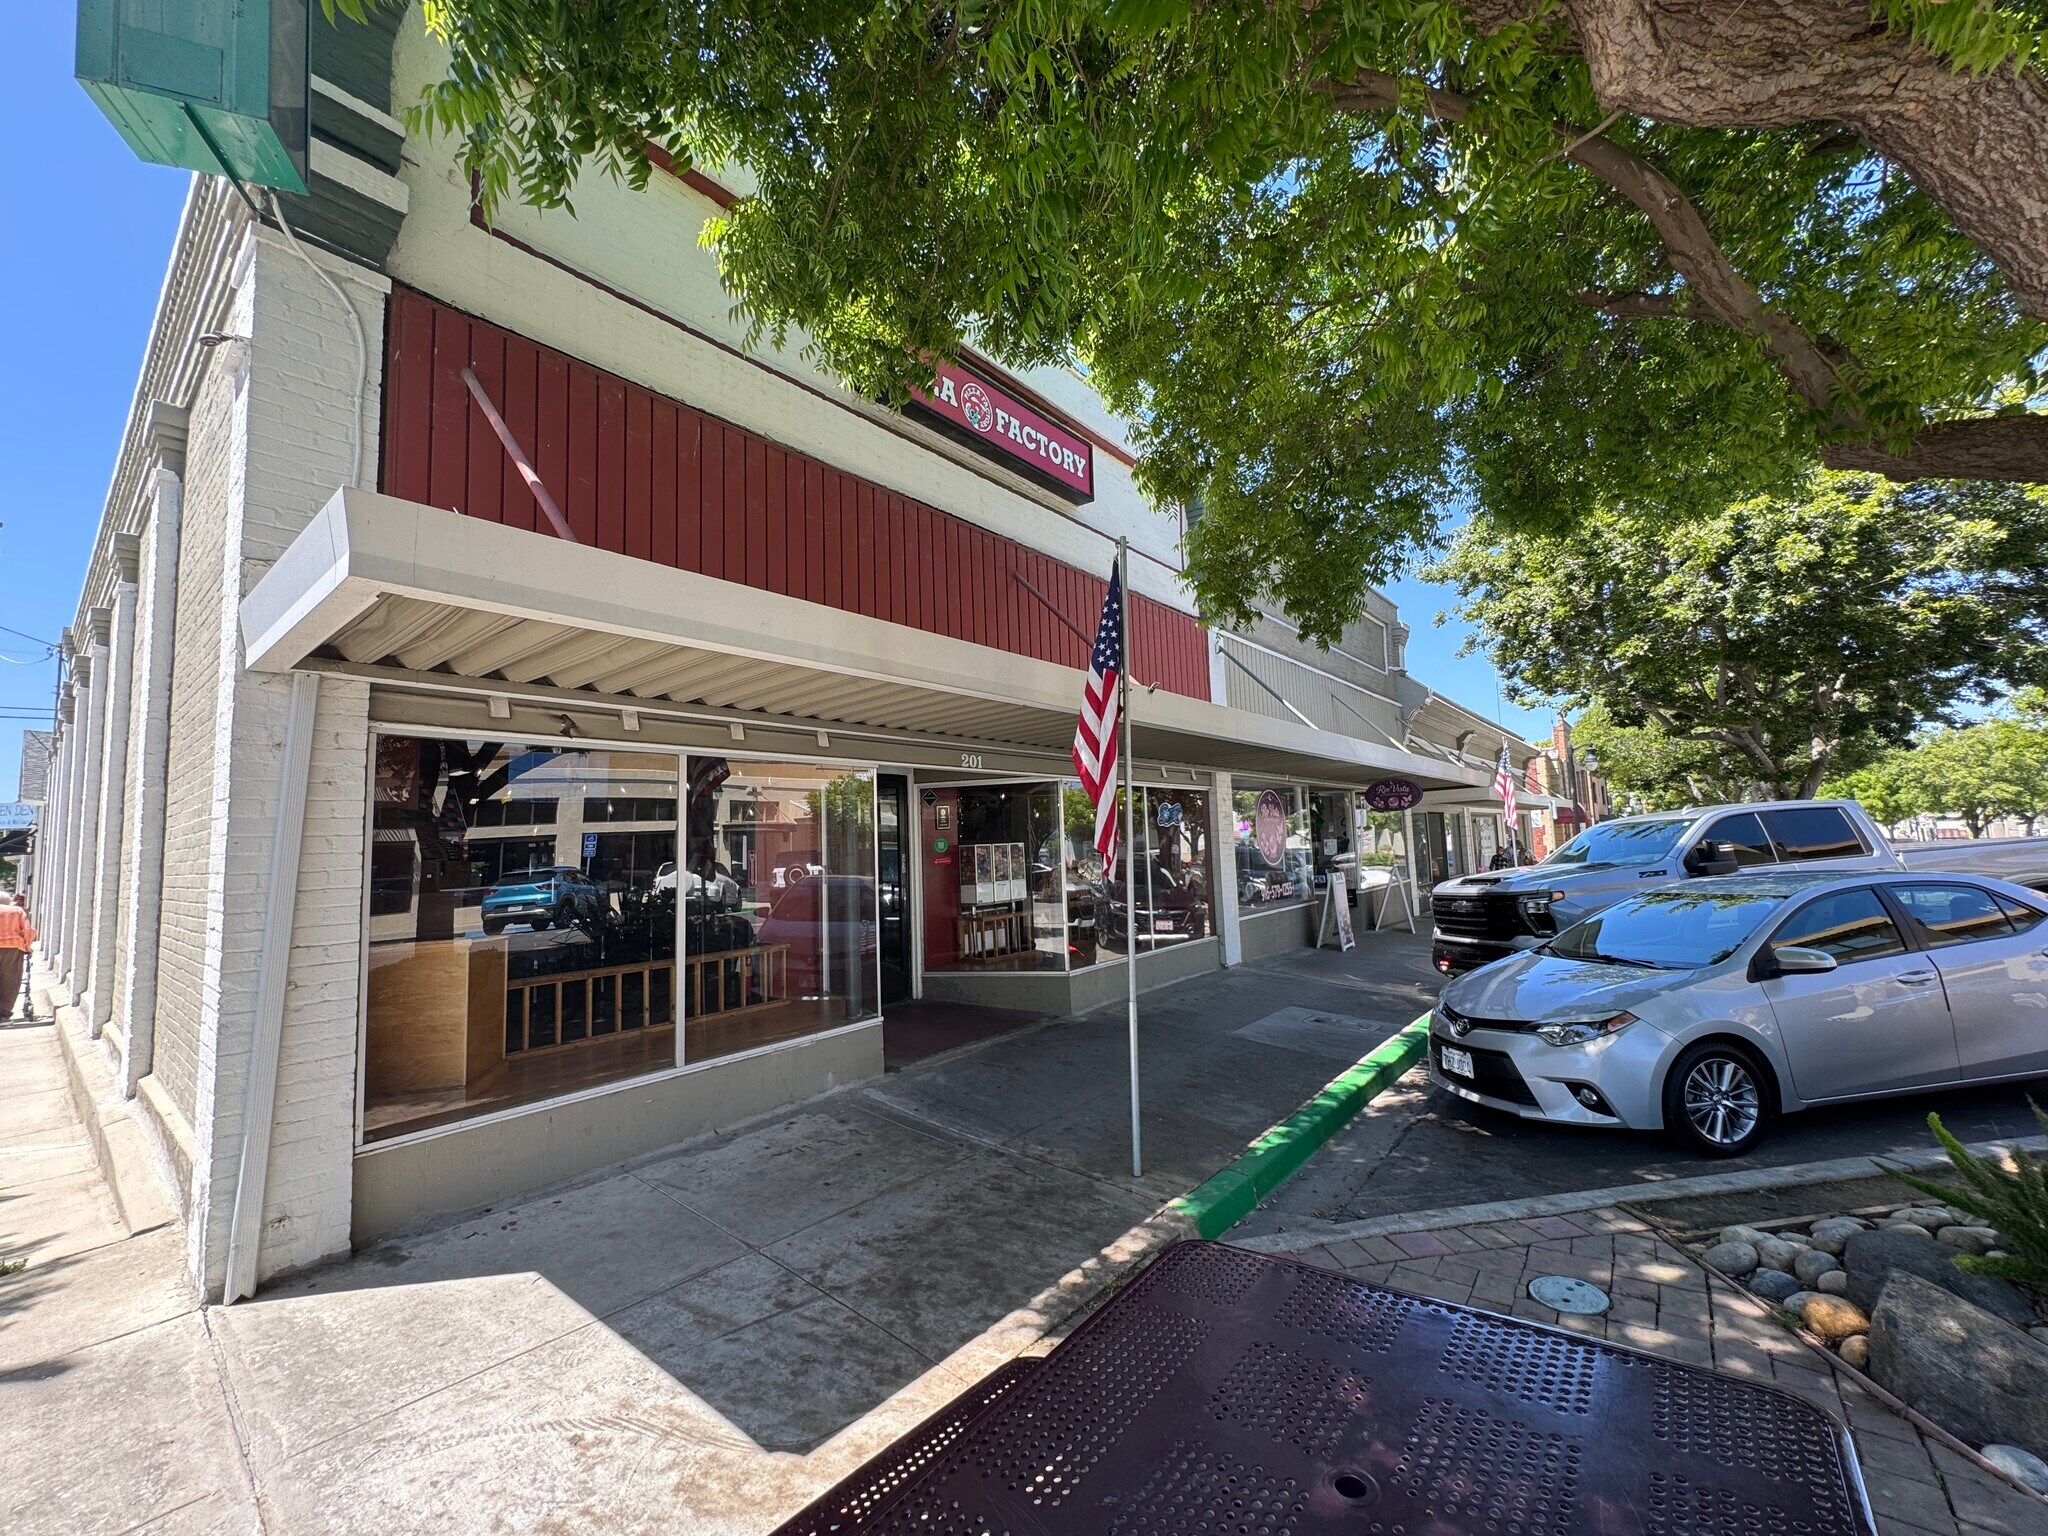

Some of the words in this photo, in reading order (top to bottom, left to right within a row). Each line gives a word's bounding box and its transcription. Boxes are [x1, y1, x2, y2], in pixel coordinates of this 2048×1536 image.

[995, 408, 1086, 478] FACTORY
[961, 753, 983, 768] 201
[1376, 785, 1390, 794] Rio
[1390, 781, 1410, 792] Vista
[15, 804, 34, 816] DEN
